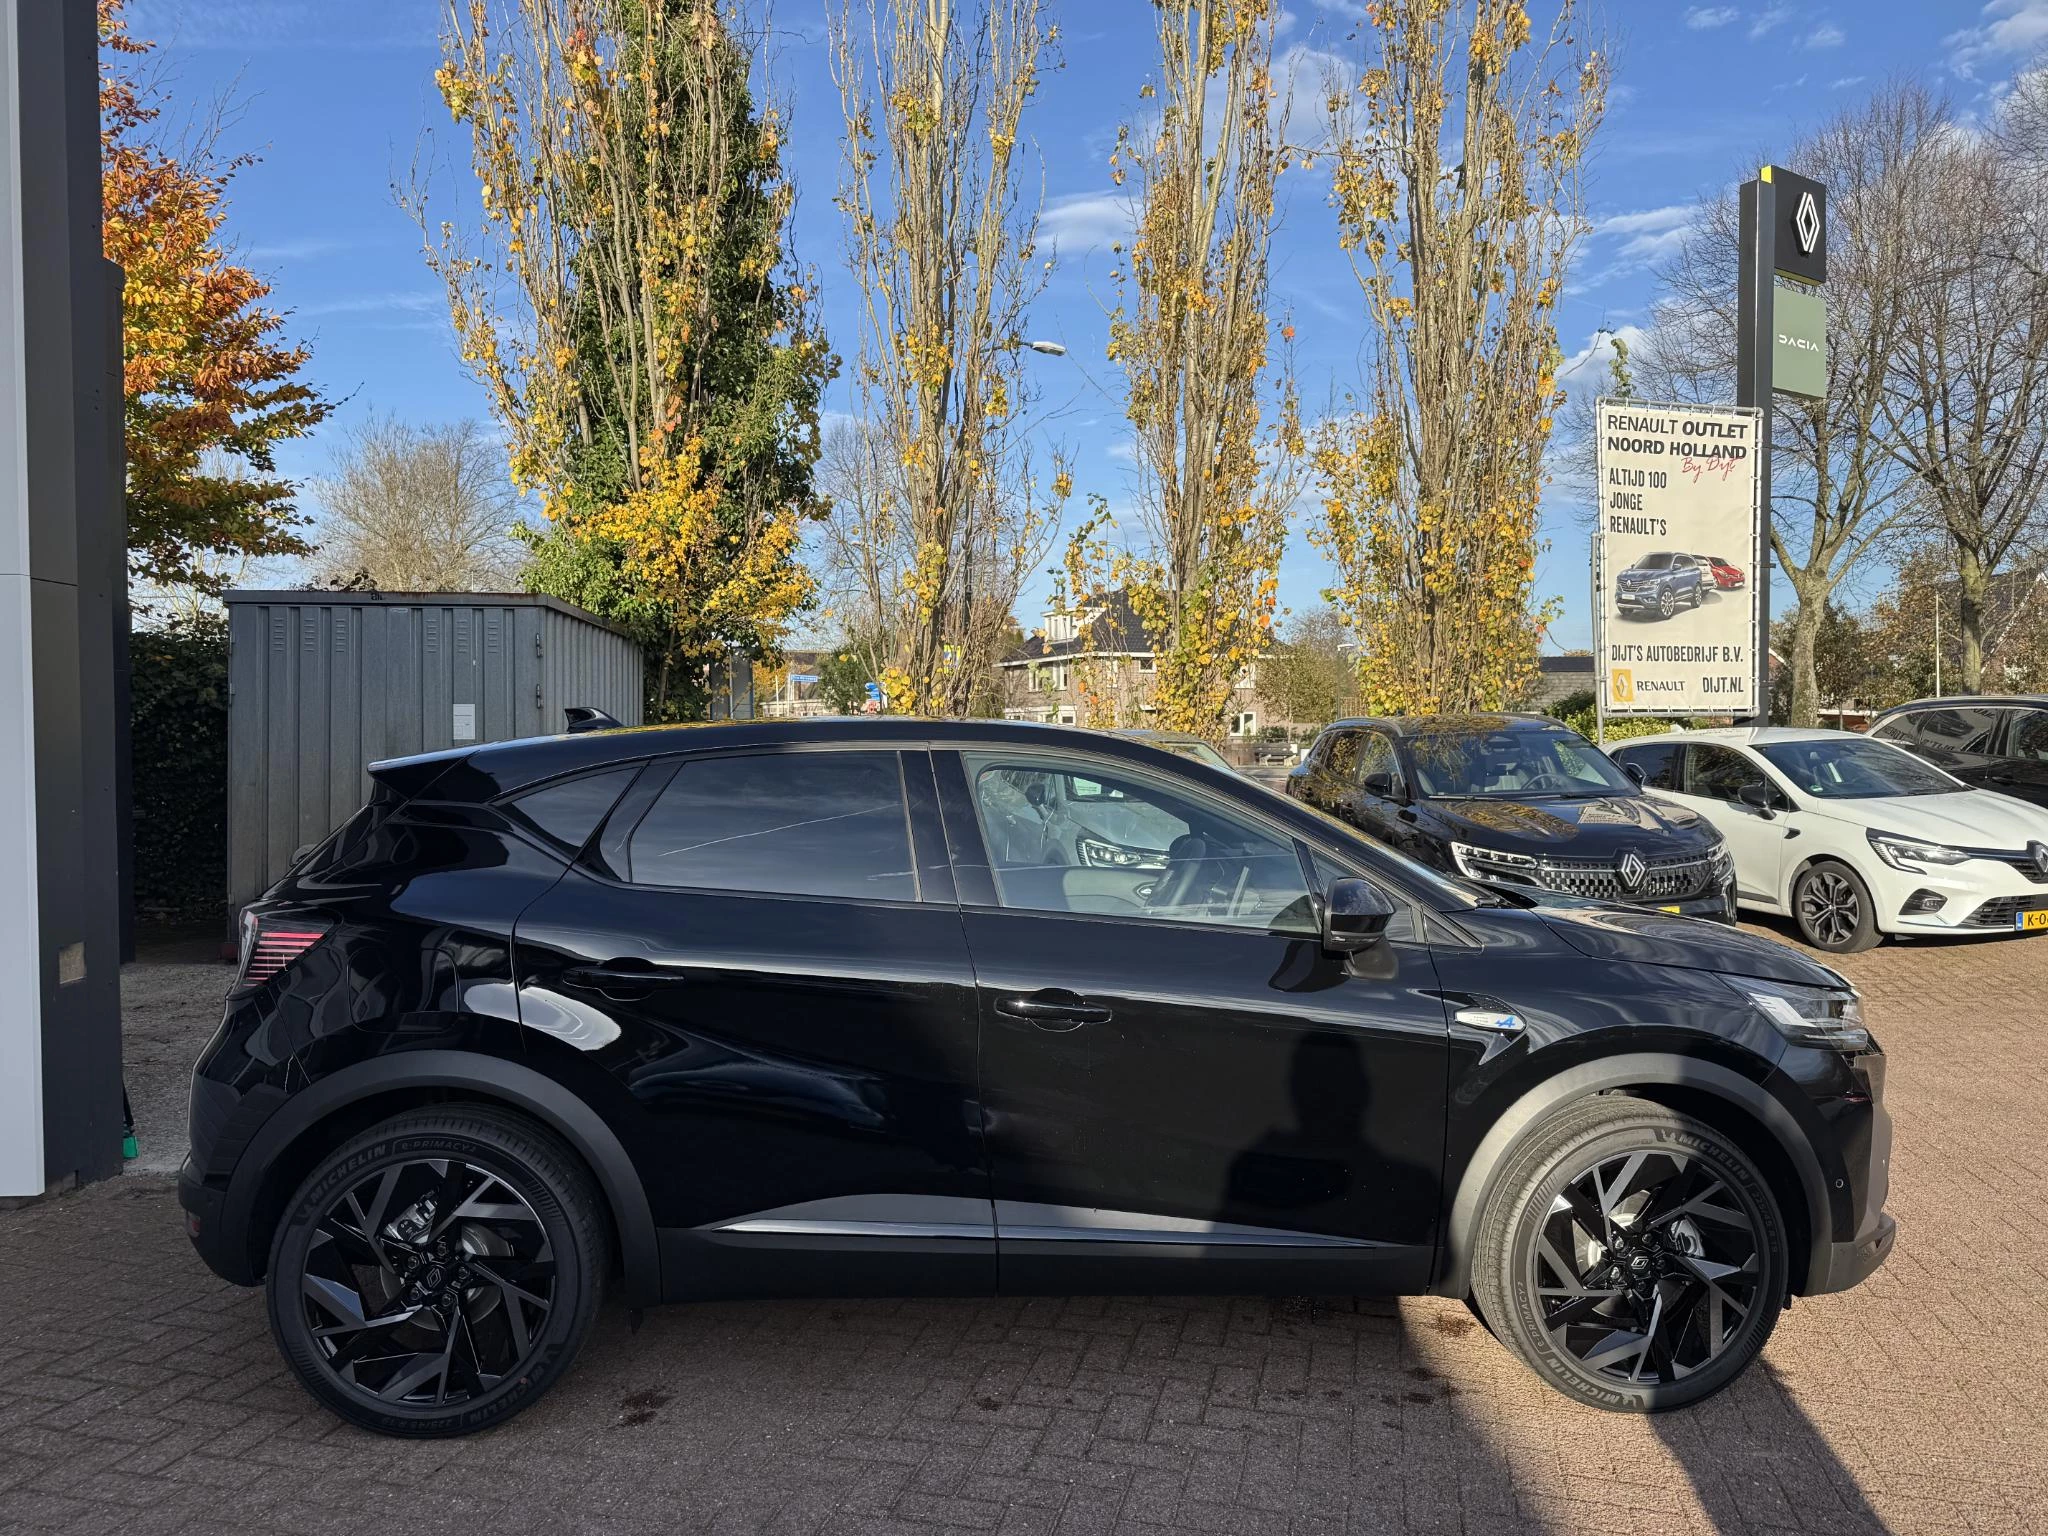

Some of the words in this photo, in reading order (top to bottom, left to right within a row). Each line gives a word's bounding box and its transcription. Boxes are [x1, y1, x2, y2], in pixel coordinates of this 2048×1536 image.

[1778, 334, 1819, 352] DACIA
[1607, 414, 1678, 434] RENAULT
[1682, 420, 1748, 439] OUTLET
[1607, 437, 1665, 455] NOORD
[1669, 442, 1747, 459] HOLLAND
[1609, 467, 1645, 487] ALTIJD
[1648, 471, 1667, 489] 100
[1681, 457, 1703, 484] By
[1609, 491, 1643, 511] JONGE
[1609, 515, 1667, 536] RENAULT'S
[1611, 644, 1642, 662] DIJT'S
[1646, 645, 1719, 663] AUTOBEDRIJF
[1722, 646, 1744, 663] B.V.
[1636, 680, 1686, 692] RENAULT
[1702, 676, 1744, 694] DIJT.NL
[1679, 1133, 1749, 1181] MICHELIN
[310, 1144, 387, 1203] MICHELIN
[1547, 1357, 1621, 1405] MICHELIN
